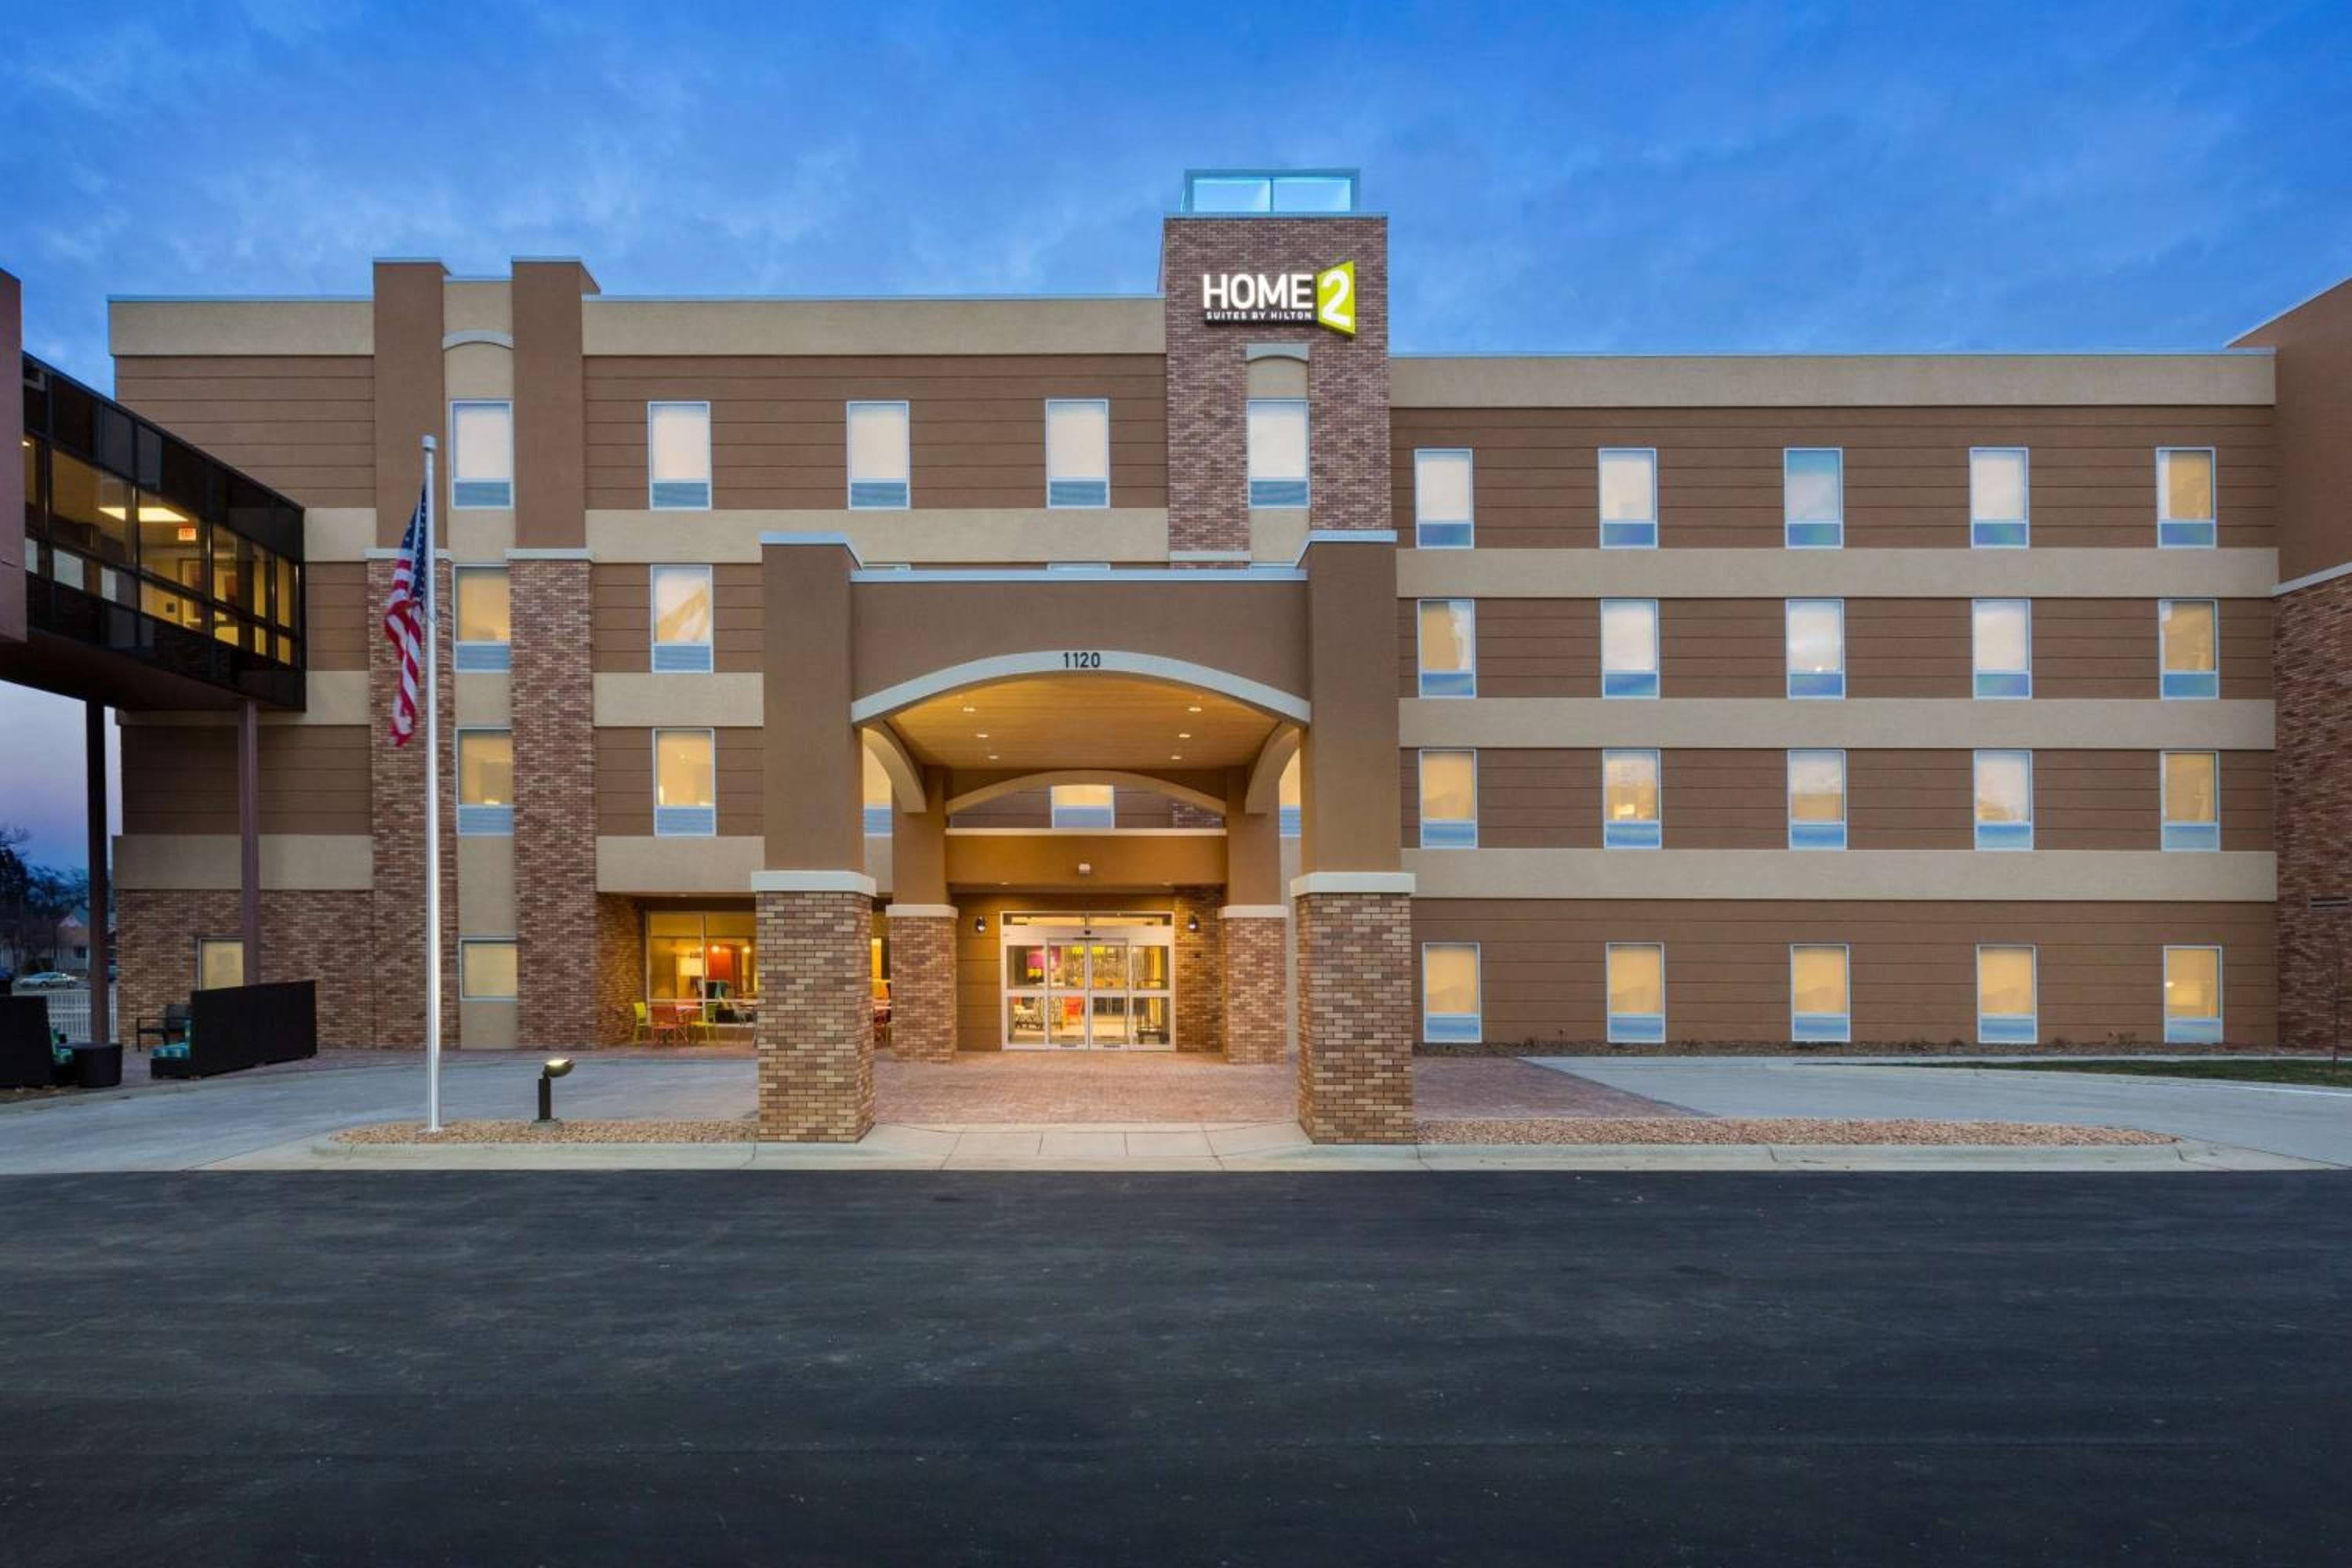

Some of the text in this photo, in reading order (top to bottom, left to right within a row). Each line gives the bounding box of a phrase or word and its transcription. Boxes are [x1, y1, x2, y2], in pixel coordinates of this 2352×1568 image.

[1203, 270, 1350, 326] HOME 2
[1207, 311, 1312, 320] SUITES BY HILTON
[1063, 652, 1101, 668] 1120
